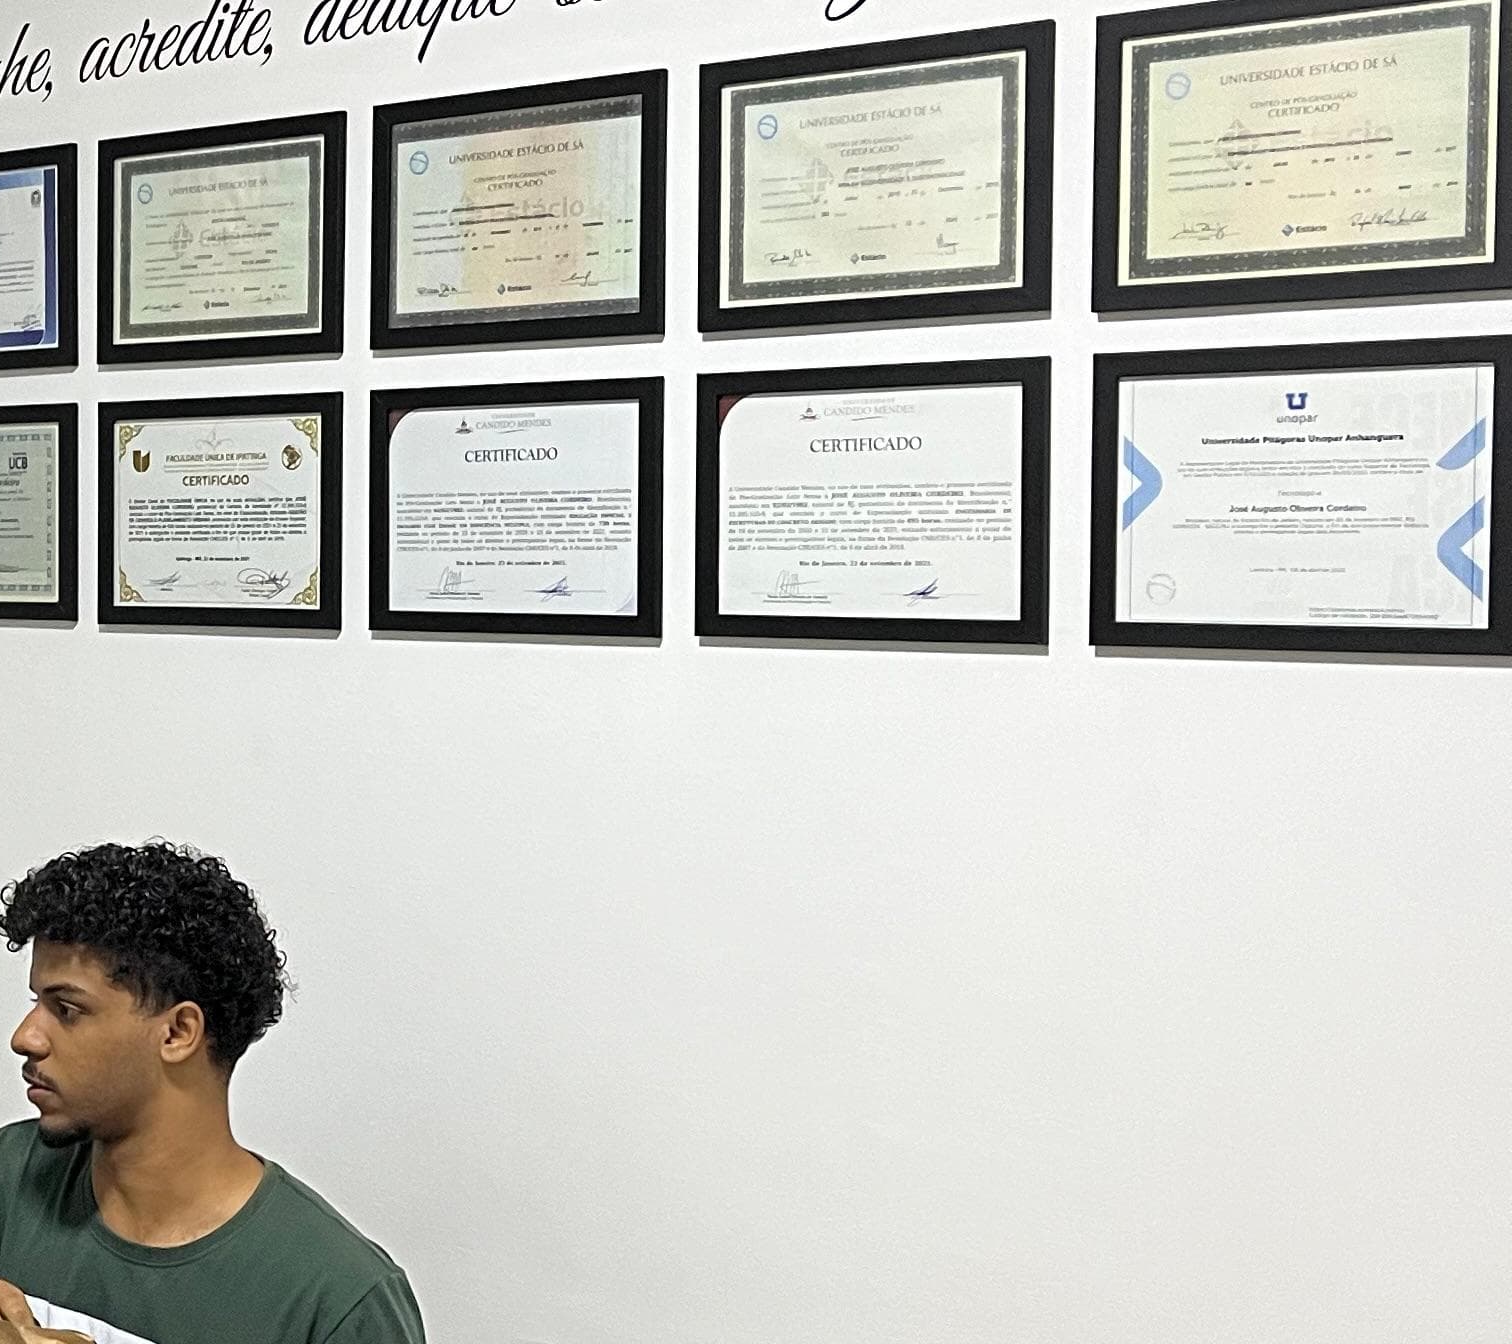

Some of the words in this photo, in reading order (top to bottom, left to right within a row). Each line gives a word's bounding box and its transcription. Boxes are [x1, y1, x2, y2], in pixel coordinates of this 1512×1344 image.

[1220, 66, 1305, 86] UNIVERSIDADE
[1309, 60, 1359, 76] ESTÁCIO
[1363, 58, 1378, 70] DE
[1383, 56, 1398, 68] SÁ
[799, 113, 869, 129] UNIVERSIDADE
[871, 107, 912, 121] ESTÁCIO
[913, 105, 927, 116] DE
[930, 104, 943, 114] SÁ
[1267, 101, 1340, 119] CERTIFICADO
[449, 149, 514, 165] UNIVERSIDADE
[516, 143, 555, 156] ESTÁCIO
[557, 141, 569, 152] DE
[572, 138, 584, 150] SÁ
[840, 144, 900, 157] CERTIFICADO
[487, 178, 543, 191] CERTIFICADO
[824, 406, 872, 416] CANDIDO
[874, 404, 915, 414] MENDES
[1276, 414, 1318, 426] unopar
[809, 436, 923, 453] CERTIFICADO
[1201, 436, 1260, 445] Universidade
[1262, 435, 1306, 445] Pitágoras
[1308, 434, 1343, 444] Unopar
[1345, 433, 1404, 443] Anhanguera
[464, 446, 558, 463] CERTIFICADO
[182, 474, 250, 487] CERTIFICADO
[1229, 504, 1248, 513] José
[1251, 504, 1287, 514] Augusto
[1289, 504, 1324, 513] Oliveira
[1326, 504, 1367, 513] Cordeiro
